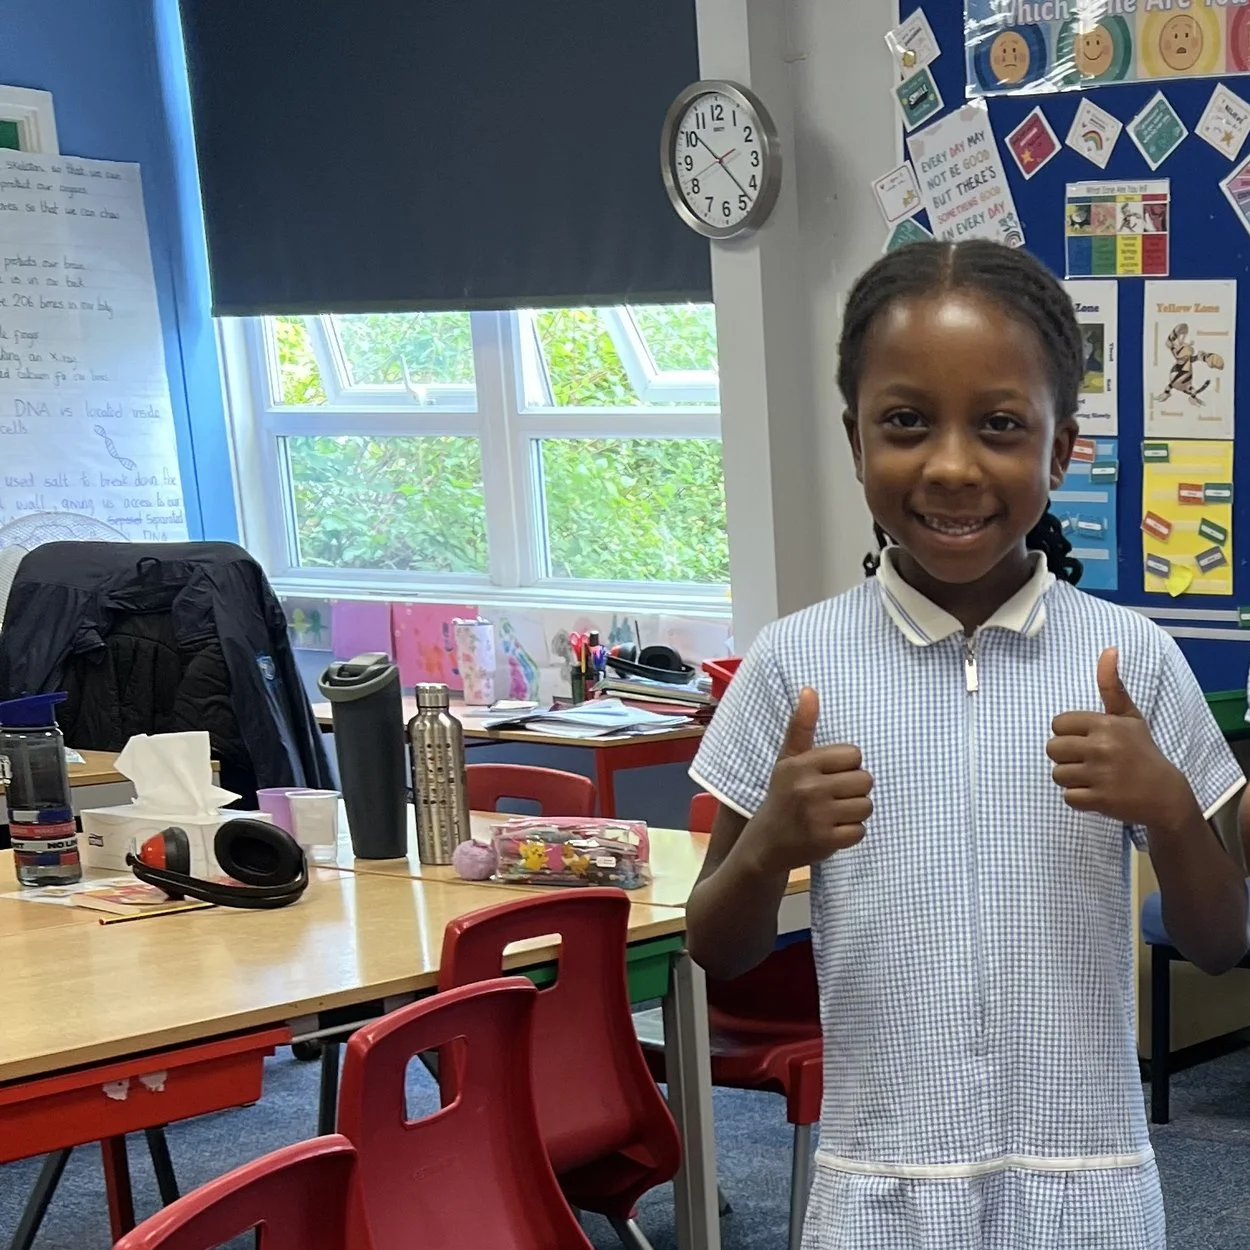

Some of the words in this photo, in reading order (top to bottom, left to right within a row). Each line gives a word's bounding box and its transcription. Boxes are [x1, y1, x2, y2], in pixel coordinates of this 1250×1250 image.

[695, 112, 706, 129] 11
[711, 104, 724, 121] 12
[732, 109, 737, 127] 1
[685, 130, 698, 148] 10
[743, 126, 753, 143] 2
[750, 150, 760, 167] 3
[920, 150, 949, 173] EVERY
[949, 141, 966, 159] DAY
[966, 130, 985, 148] MAY
[684, 155, 694, 171] 9
[926, 170, 948, 191] NOT
[949, 163, 962, 179] BE
[962, 148, 990, 170] GOOD
[691, 178, 700, 194] 8
[749, 174, 758, 191] 4
[932, 188, 952, 209] BUT
[955, 165, 997, 196] THERE'S
[705, 197, 714, 213] 7
[722, 201, 731, 217] 6
[738, 194, 747, 211] 5
[956, 211, 986, 235] EVERY
[987, 200, 1006, 219] DAY
[1075, 303, 1100, 313] Zone
[1156, 303, 1192, 313] Yellow
[1194, 303, 1220, 313] Zone
[15, 399, 50, 417] DNA
[85, 400, 123, 418] located
[5, 472, 35, 487] used
[44, 473, 70, 487] salt
